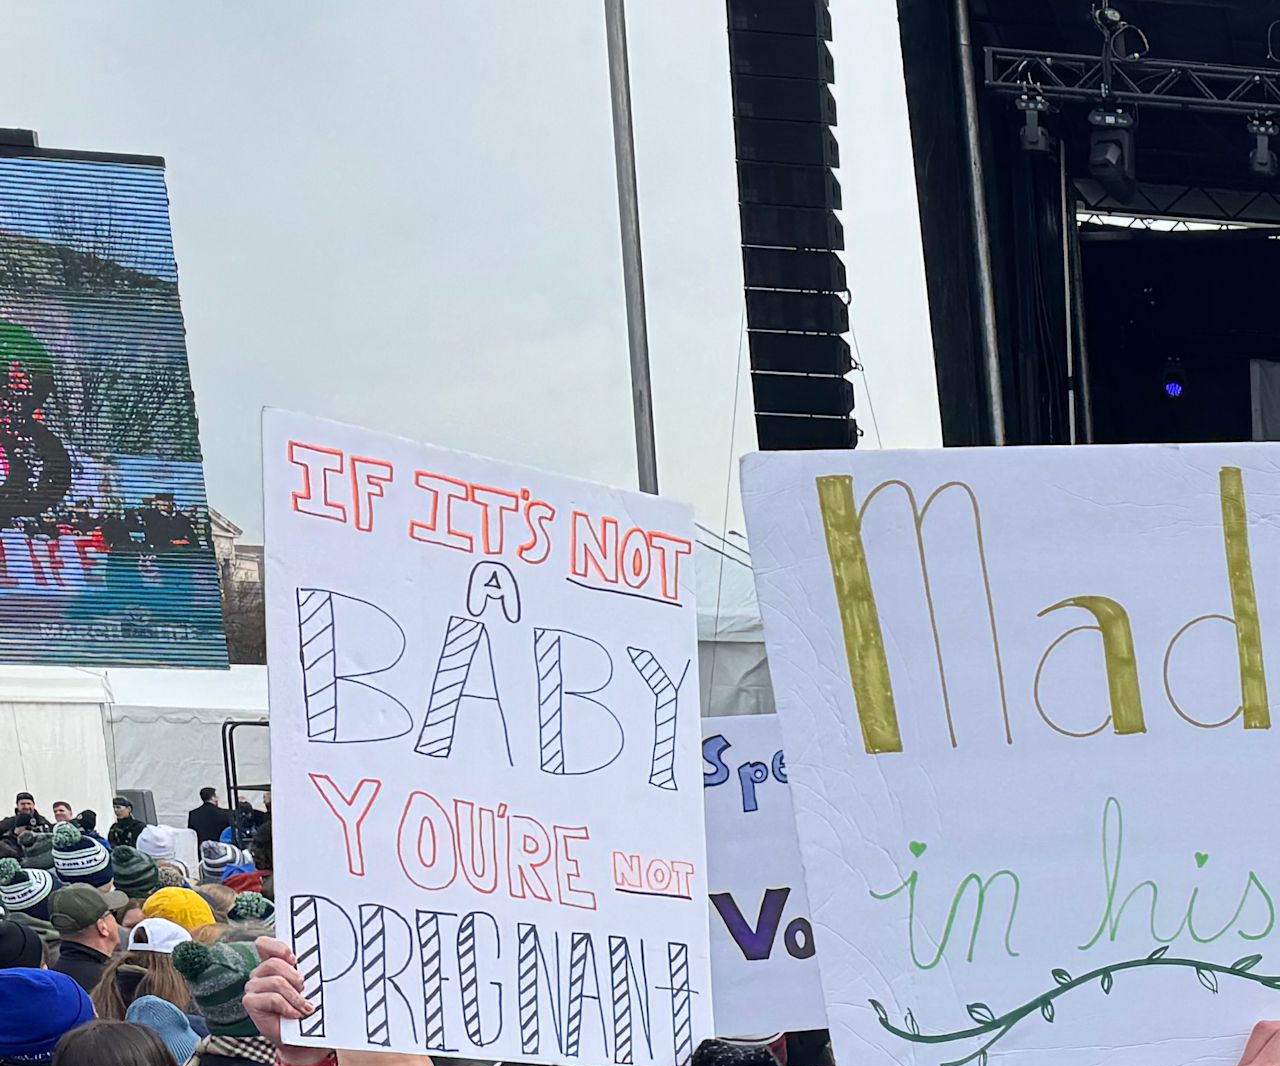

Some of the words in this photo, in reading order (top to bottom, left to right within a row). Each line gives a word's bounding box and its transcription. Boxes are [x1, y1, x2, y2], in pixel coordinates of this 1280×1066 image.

[287, 440, 394, 532] IF
[408, 469, 557, 565] IT'S
[569, 509, 692, 600] NOT
[466, 560, 521, 624] A
[295, 586, 692, 791] BABY
[308, 772, 597, 911] YOU'RE
[611, 851, 695, 899] NOT
[868, 840, 1021, 971] in
[1077, 796, 1275, 953] his
